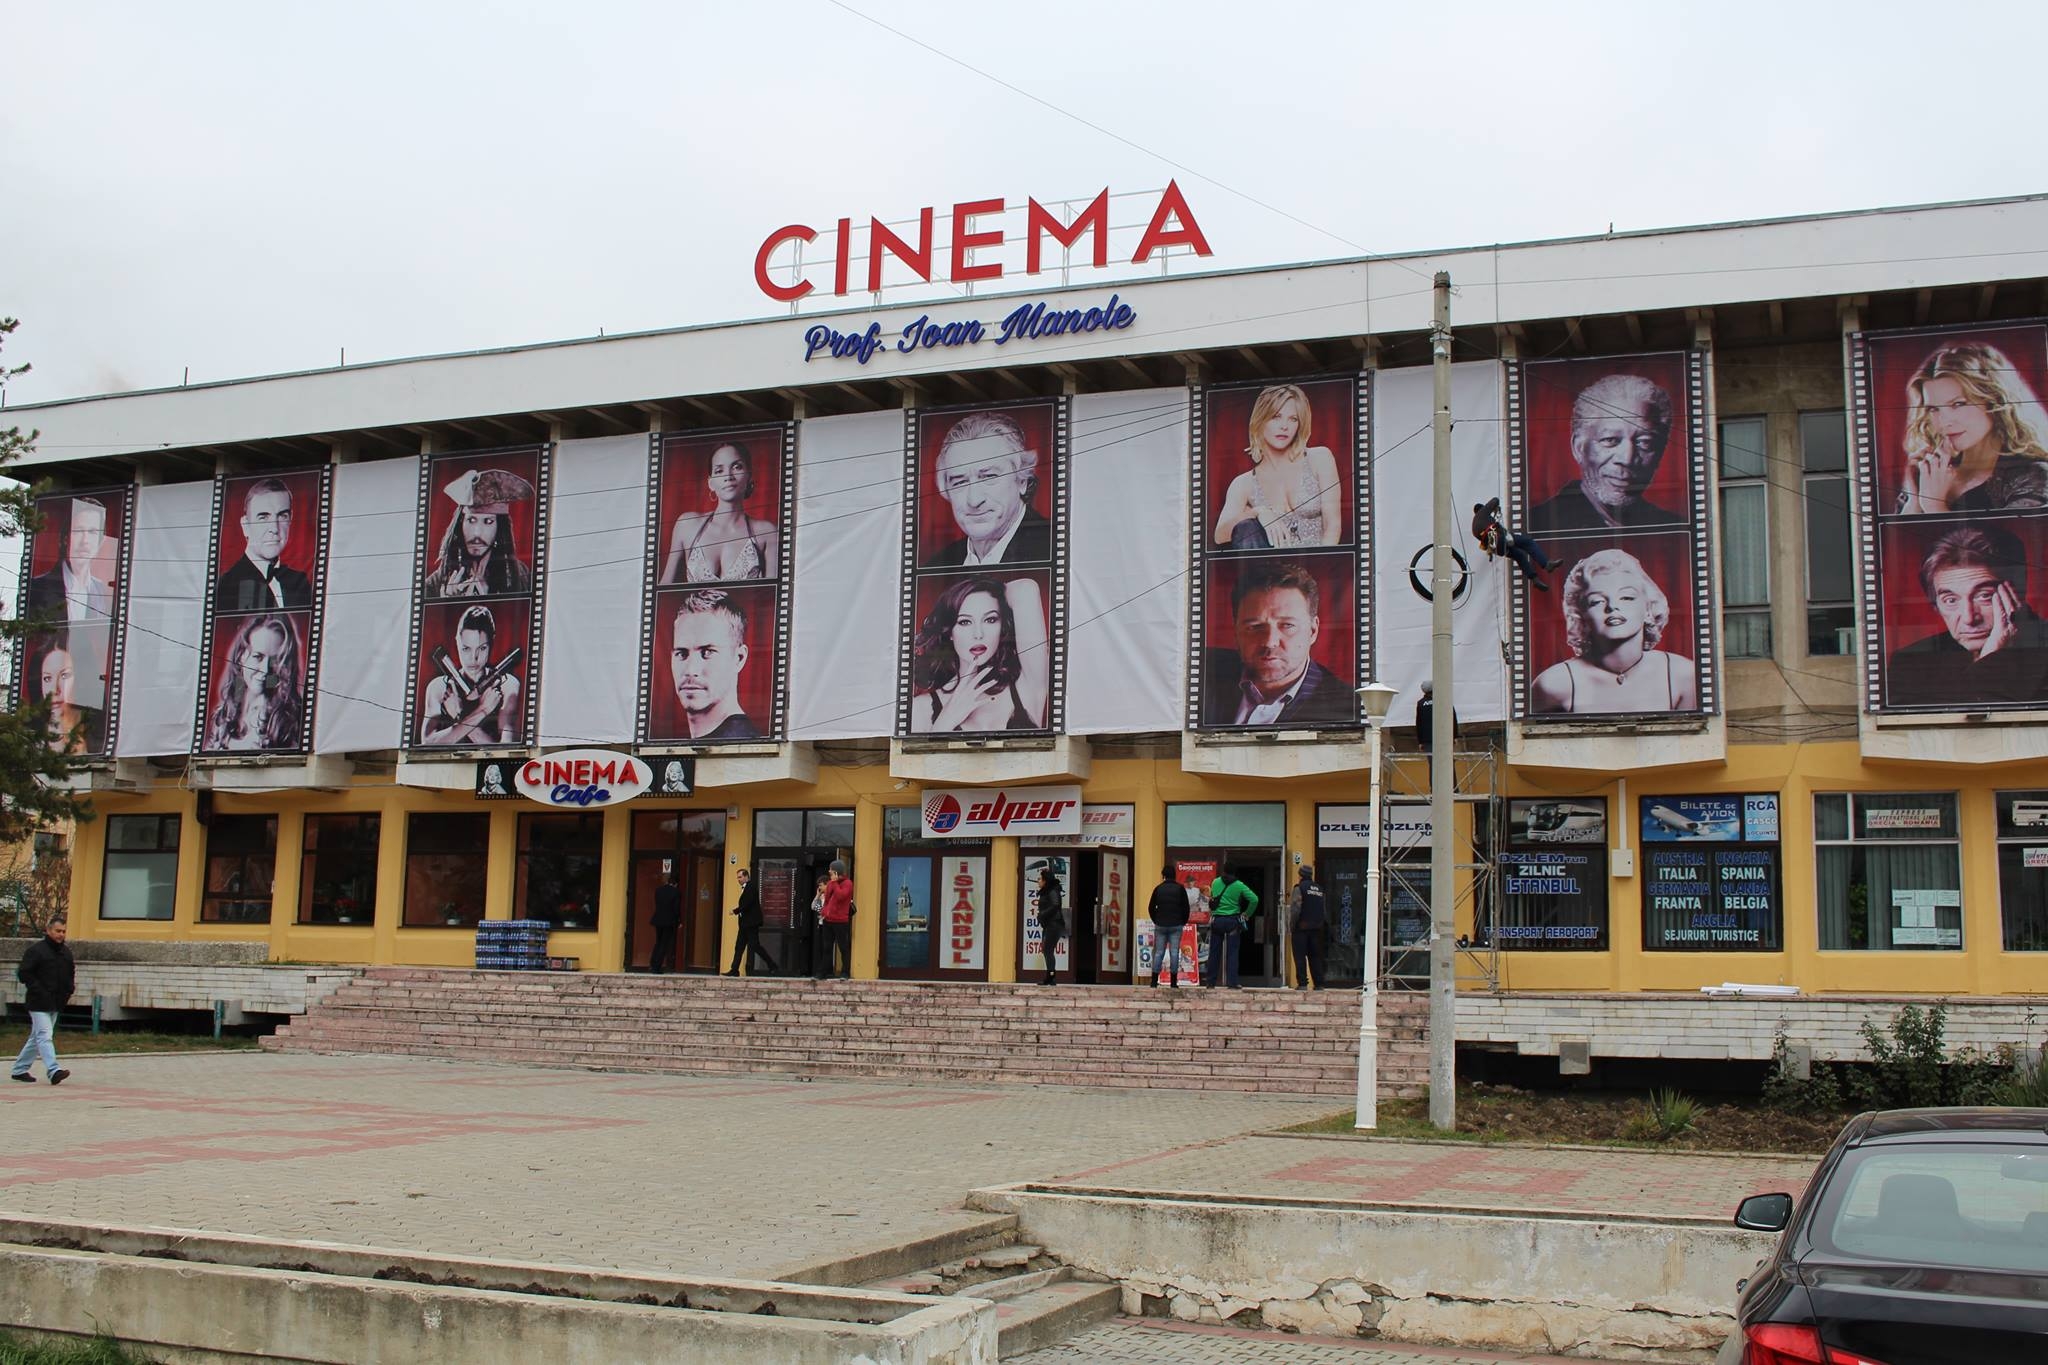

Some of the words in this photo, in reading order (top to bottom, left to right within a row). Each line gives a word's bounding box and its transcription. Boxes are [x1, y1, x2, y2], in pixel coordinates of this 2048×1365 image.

[754, 178, 1214, 302] CINEMA
[804, 322, 887, 365] Prof.
[994, 294, 1138, 345] Manole
[522, 759, 640, 786] CINEMA
[550, 784, 611, 806] Cafe
[966, 791, 1076, 831] alpar
[1680, 801, 1721, 809] BILETE
[1747, 800, 1776, 811] RCA
[1701, 809, 1736, 817] AVION
[1654, 852, 1706, 866] AUSTRIA
[1715, 852, 1771, 865] UNGARIA
[1519, 865, 1567, 876] ZILNIC
[1660, 867, 1697, 880] ITALIA
[1721, 867, 1765, 880] SPANIA
[1648, 881, 1711, 895] GERMANIA
[1720, 881, 1771, 896] OLANDA
[1655, 897, 1701, 909] FRANTA
[1725, 897, 1769, 909] BELGIA
[1691, 914, 1737, 928] ANGLIA
[1545, 927, 1599, 939] AEROPORT
[1664, 930, 1709, 941] SEJURURI
[1711, 930, 1759, 941] TURISTICE
